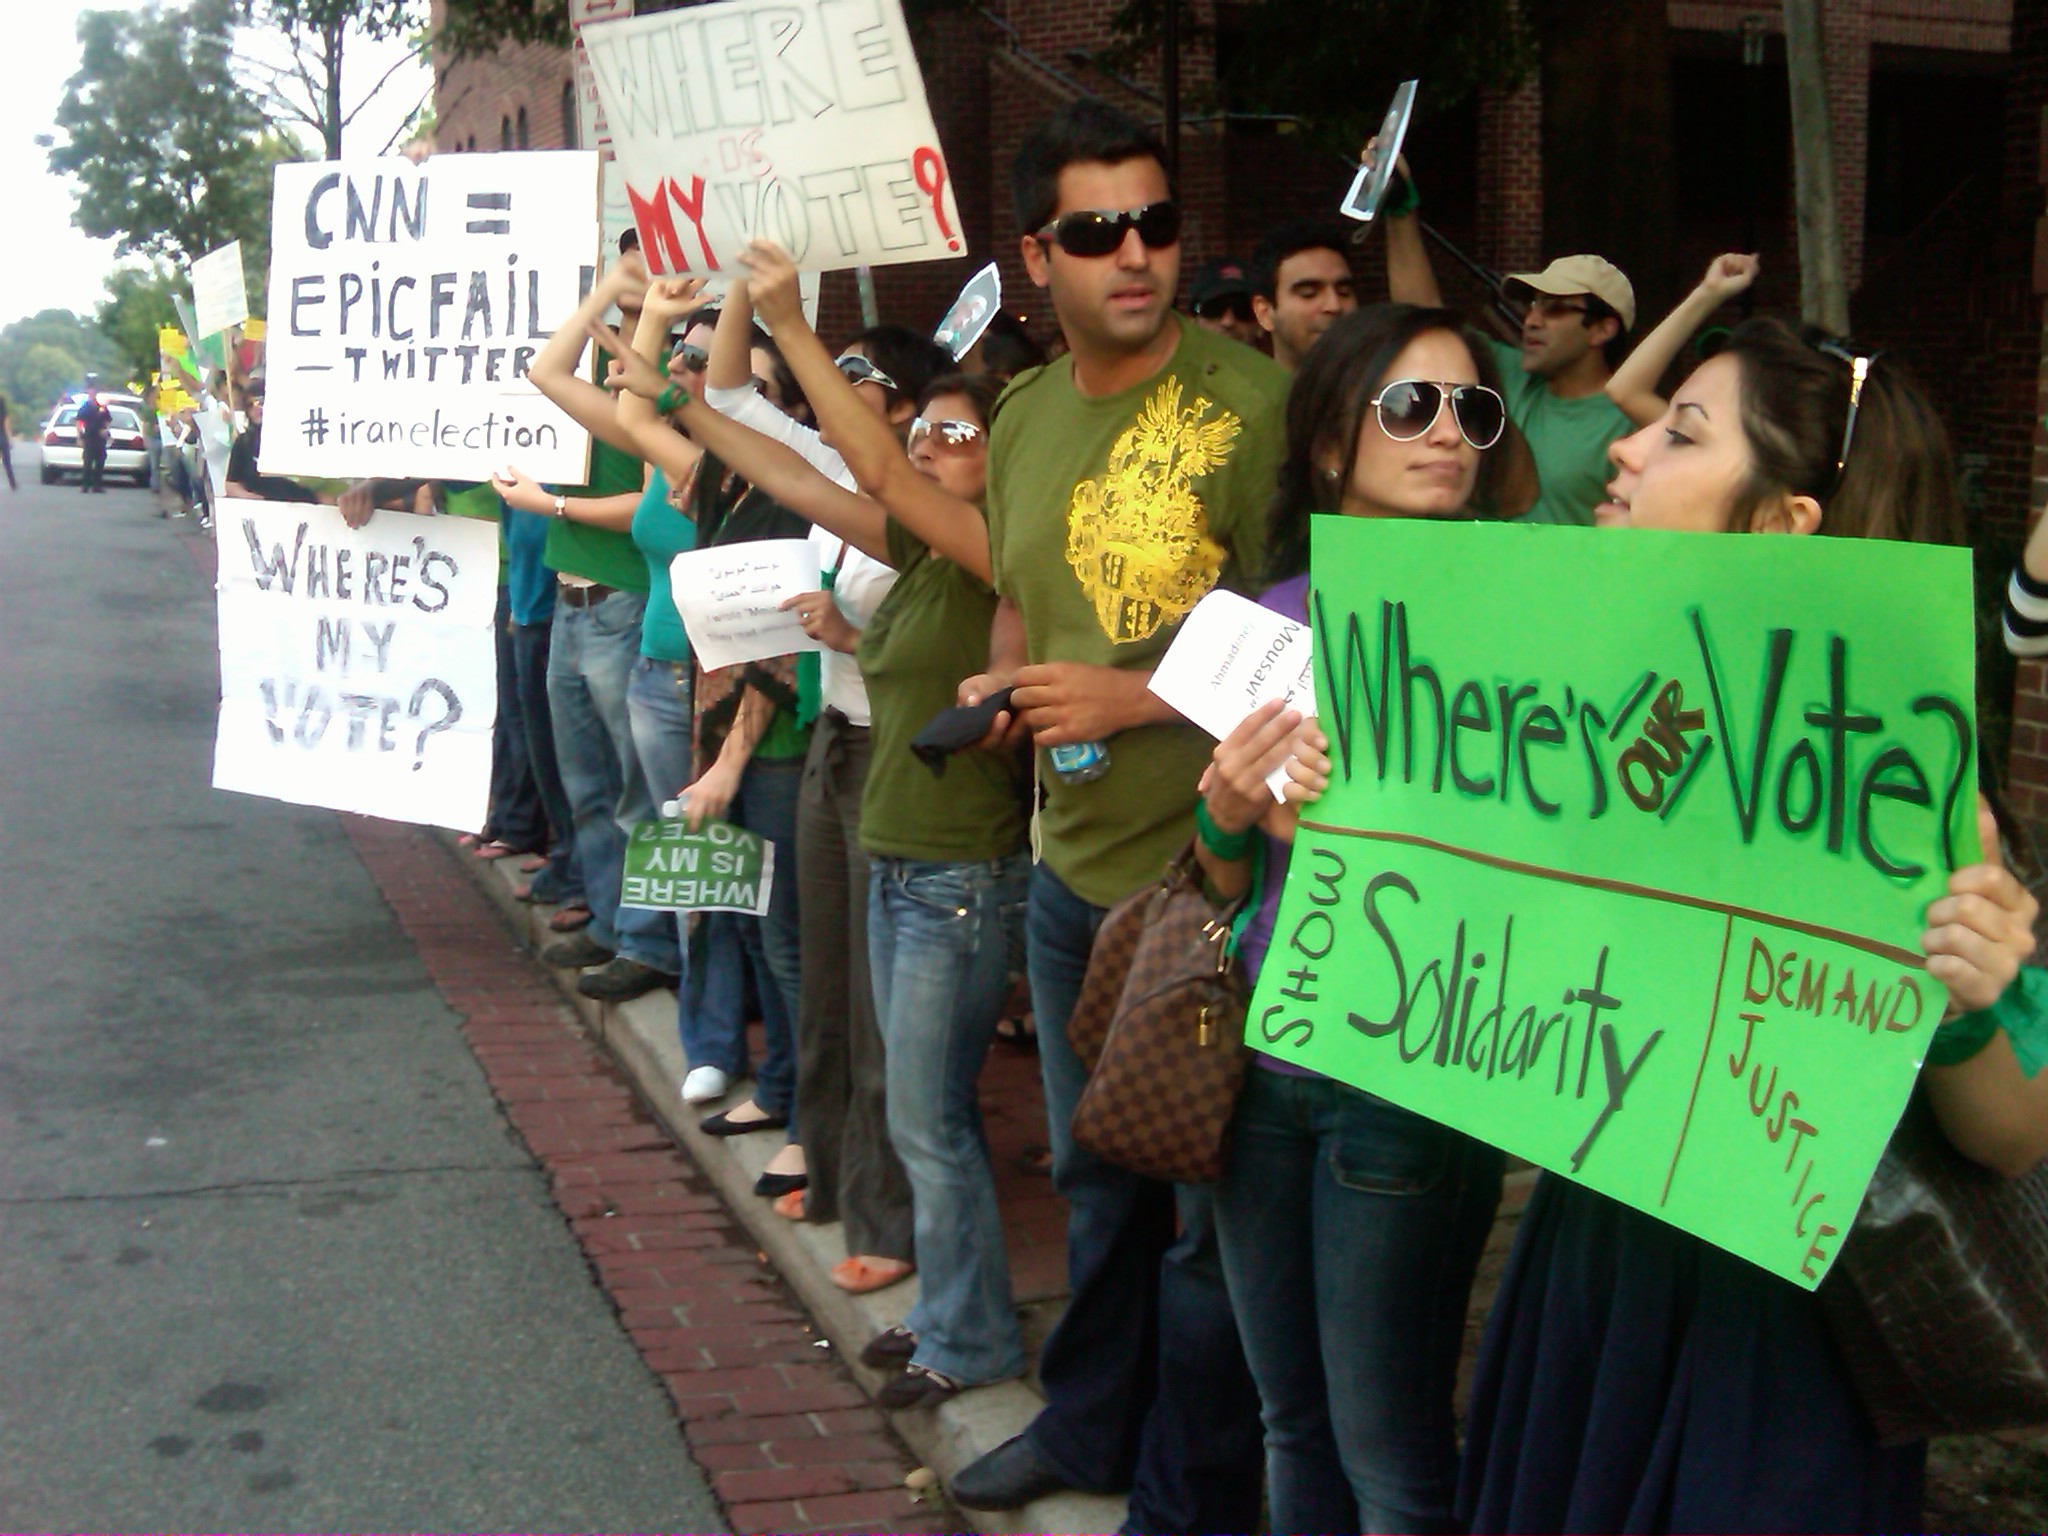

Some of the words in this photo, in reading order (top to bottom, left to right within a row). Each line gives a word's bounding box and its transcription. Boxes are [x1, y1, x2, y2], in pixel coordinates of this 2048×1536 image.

[590, 0, 907, 138] WHERE
[718, 127, 774, 178] IS
[304, 172, 429, 250] CNN
[625, 173, 720, 275] MY
[713, 145, 961, 264] VOTE?
[301, 406, 558, 450] #iranelection
[242, 518, 459, 613] WHERE'S
[316, 616, 396, 677] MY
[260, 677, 463, 771] VOTE?
[1314, 589, 1607, 820] Where's
[1616, 679, 1706, 813] OUR
[1691, 607, 1972, 878] Vote?
[625, 876, 757, 908] WHERE
[644, 847, 700, 873] MY
[711, 851, 745, 876] IS
[1261, 848, 1347, 1048] SHOW
[1744, 936, 1923, 1034] DEMAND
[1347, 871, 1665, 1174] Solidarity
[1729, 1012, 1838, 1280] JUSTICE
